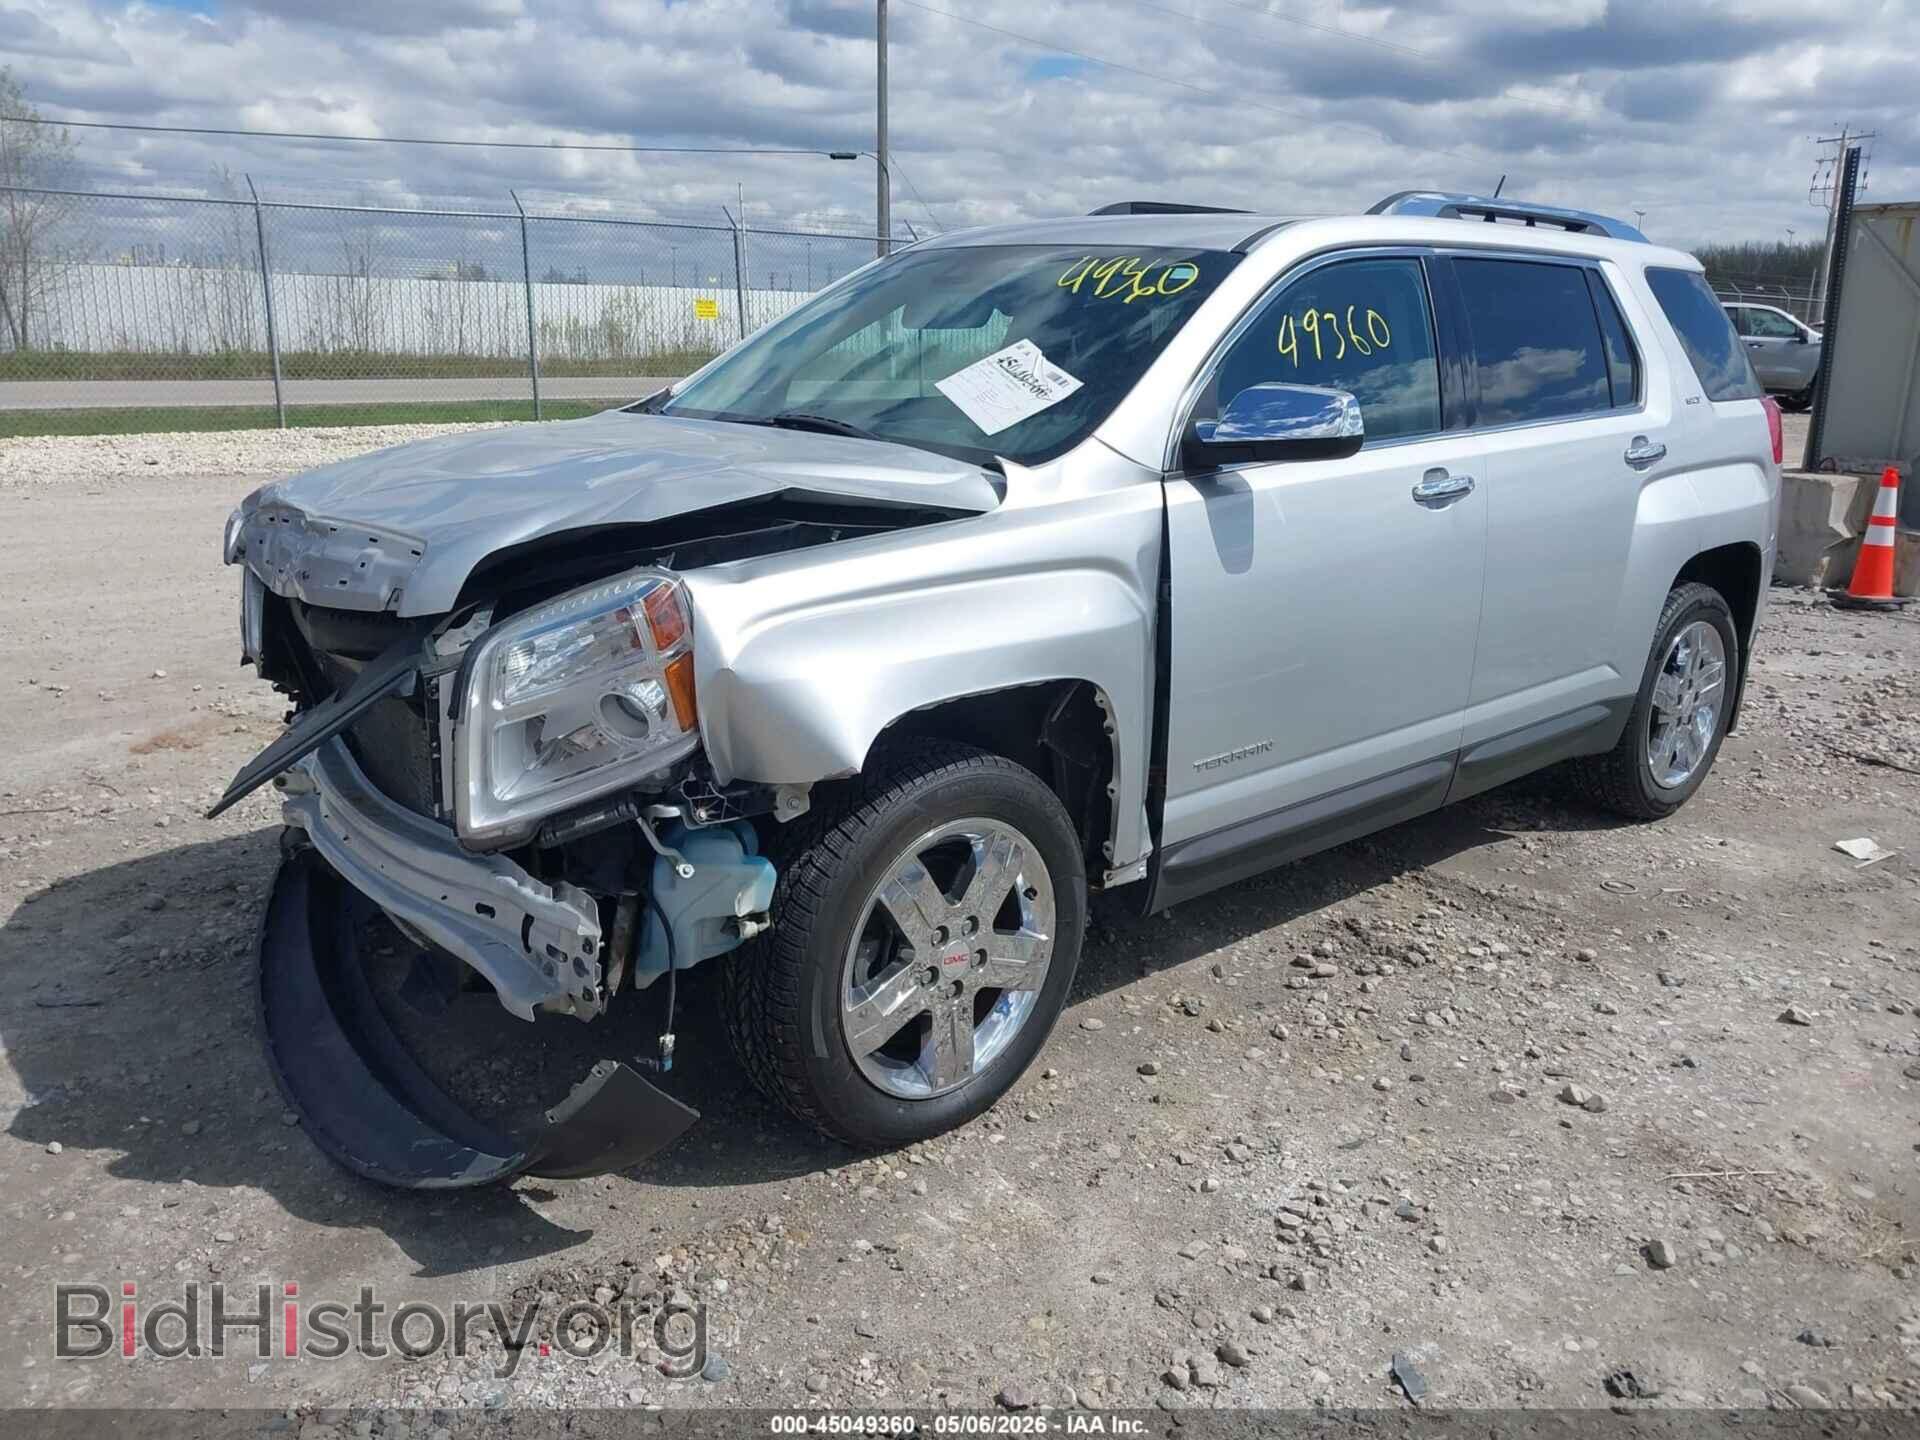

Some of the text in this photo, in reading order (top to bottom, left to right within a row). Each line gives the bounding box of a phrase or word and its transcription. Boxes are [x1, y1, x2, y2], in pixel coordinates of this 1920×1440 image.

[1057, 256, 1199, 304] 49360
[1278, 305, 1390, 368] 49360
[1191, 739, 1273, 773] TERRAIN
[943, 953, 969, 965] GMC
